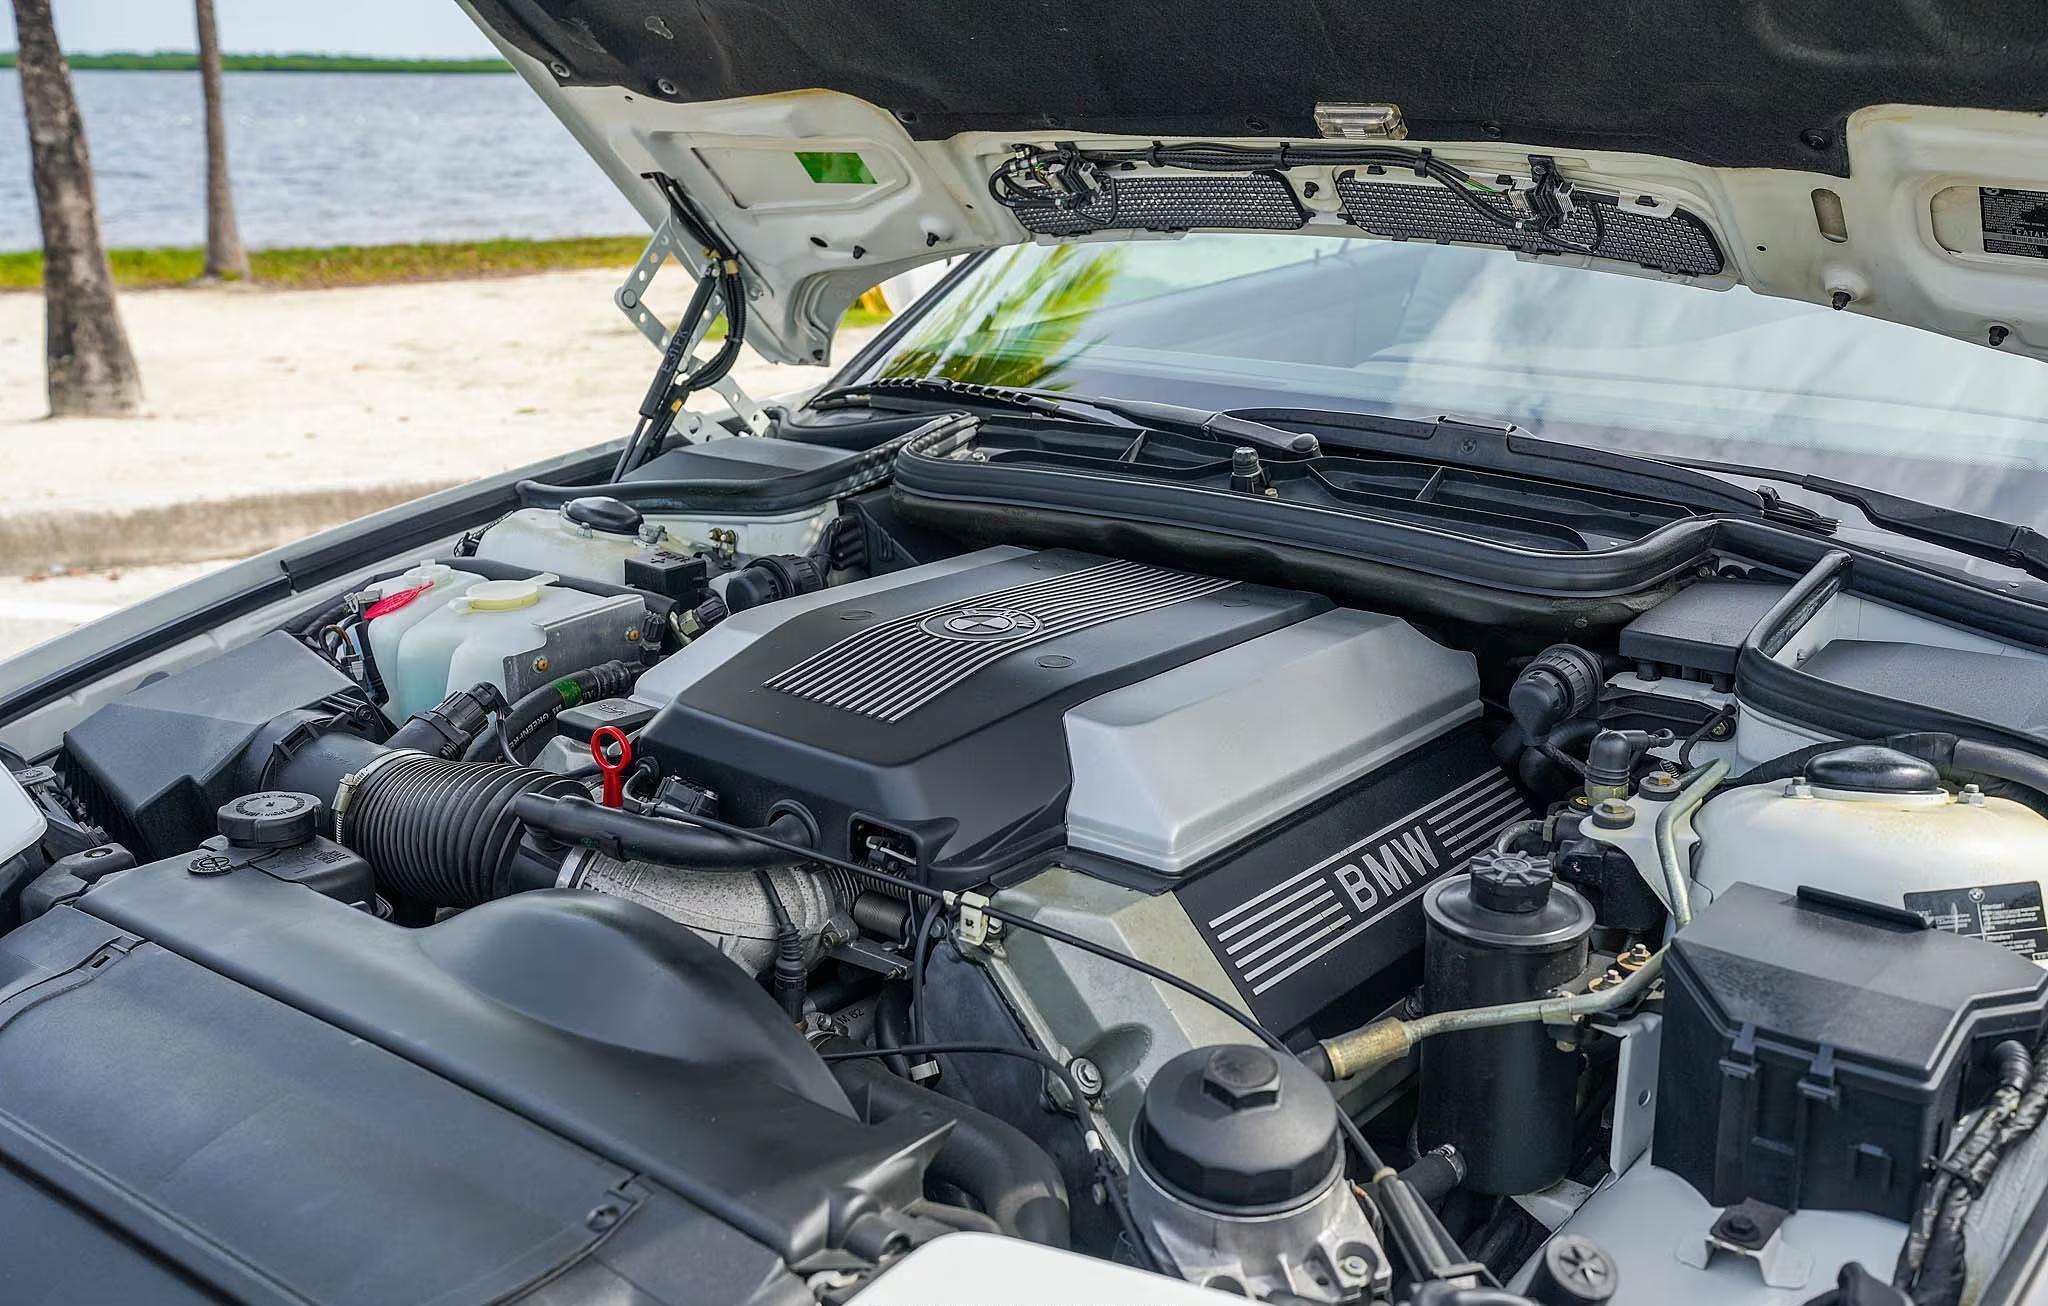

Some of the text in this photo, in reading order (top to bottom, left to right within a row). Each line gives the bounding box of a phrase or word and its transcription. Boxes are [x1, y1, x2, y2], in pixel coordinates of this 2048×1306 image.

[509, 713, 550, 751] GREENFRE
[1334, 826, 1440, 913] BMW
[848, 1007, 865, 1018] 62
